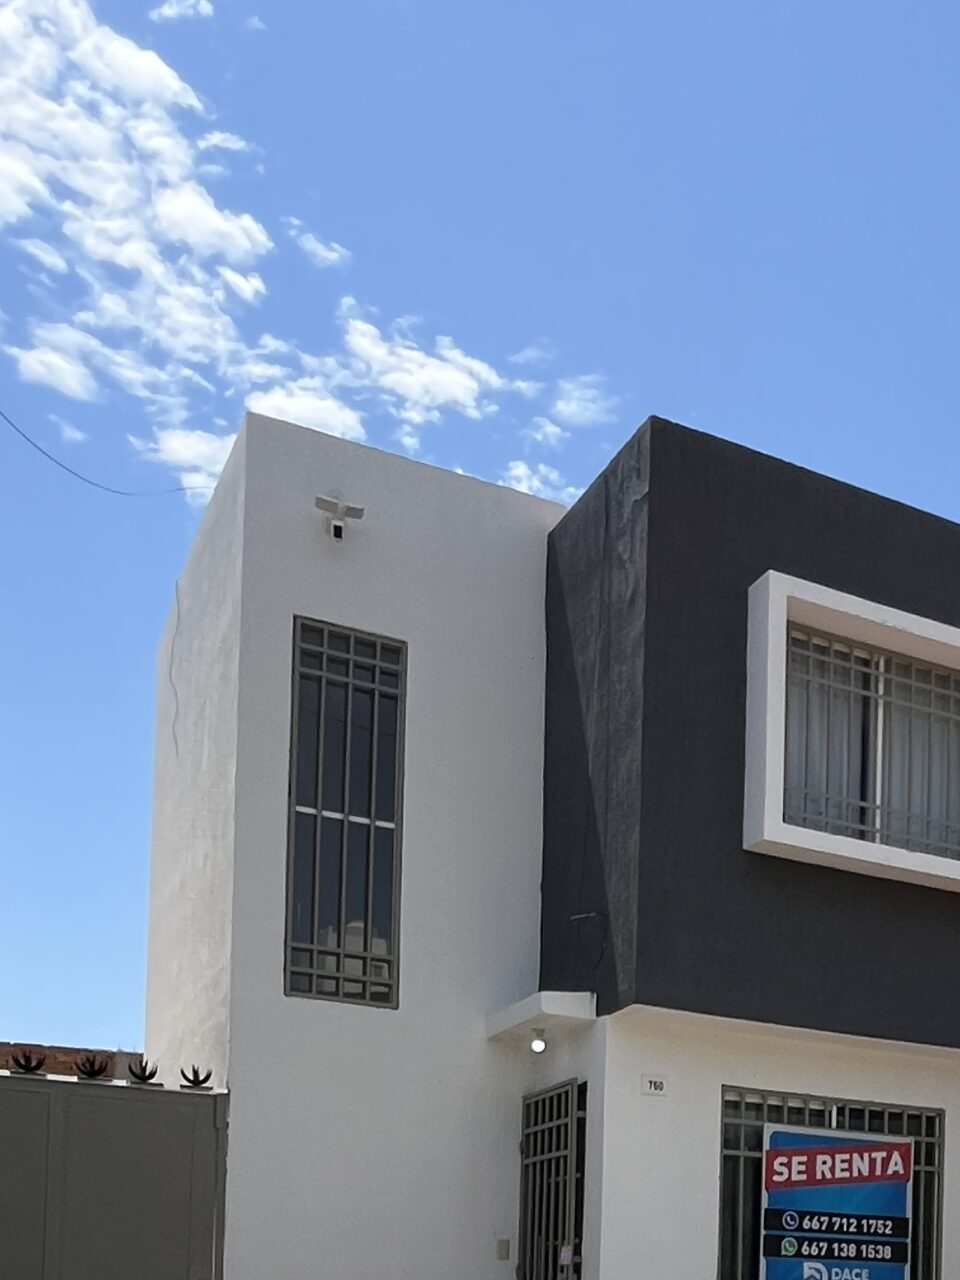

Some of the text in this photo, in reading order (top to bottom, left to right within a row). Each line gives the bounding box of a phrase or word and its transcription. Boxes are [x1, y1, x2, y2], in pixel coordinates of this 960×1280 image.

[772, 1150, 905, 1182] SE RENTA
[802, 1215, 893, 1235] 667 712 1752
[801, 1241, 892, 1259] 667 138 1538
